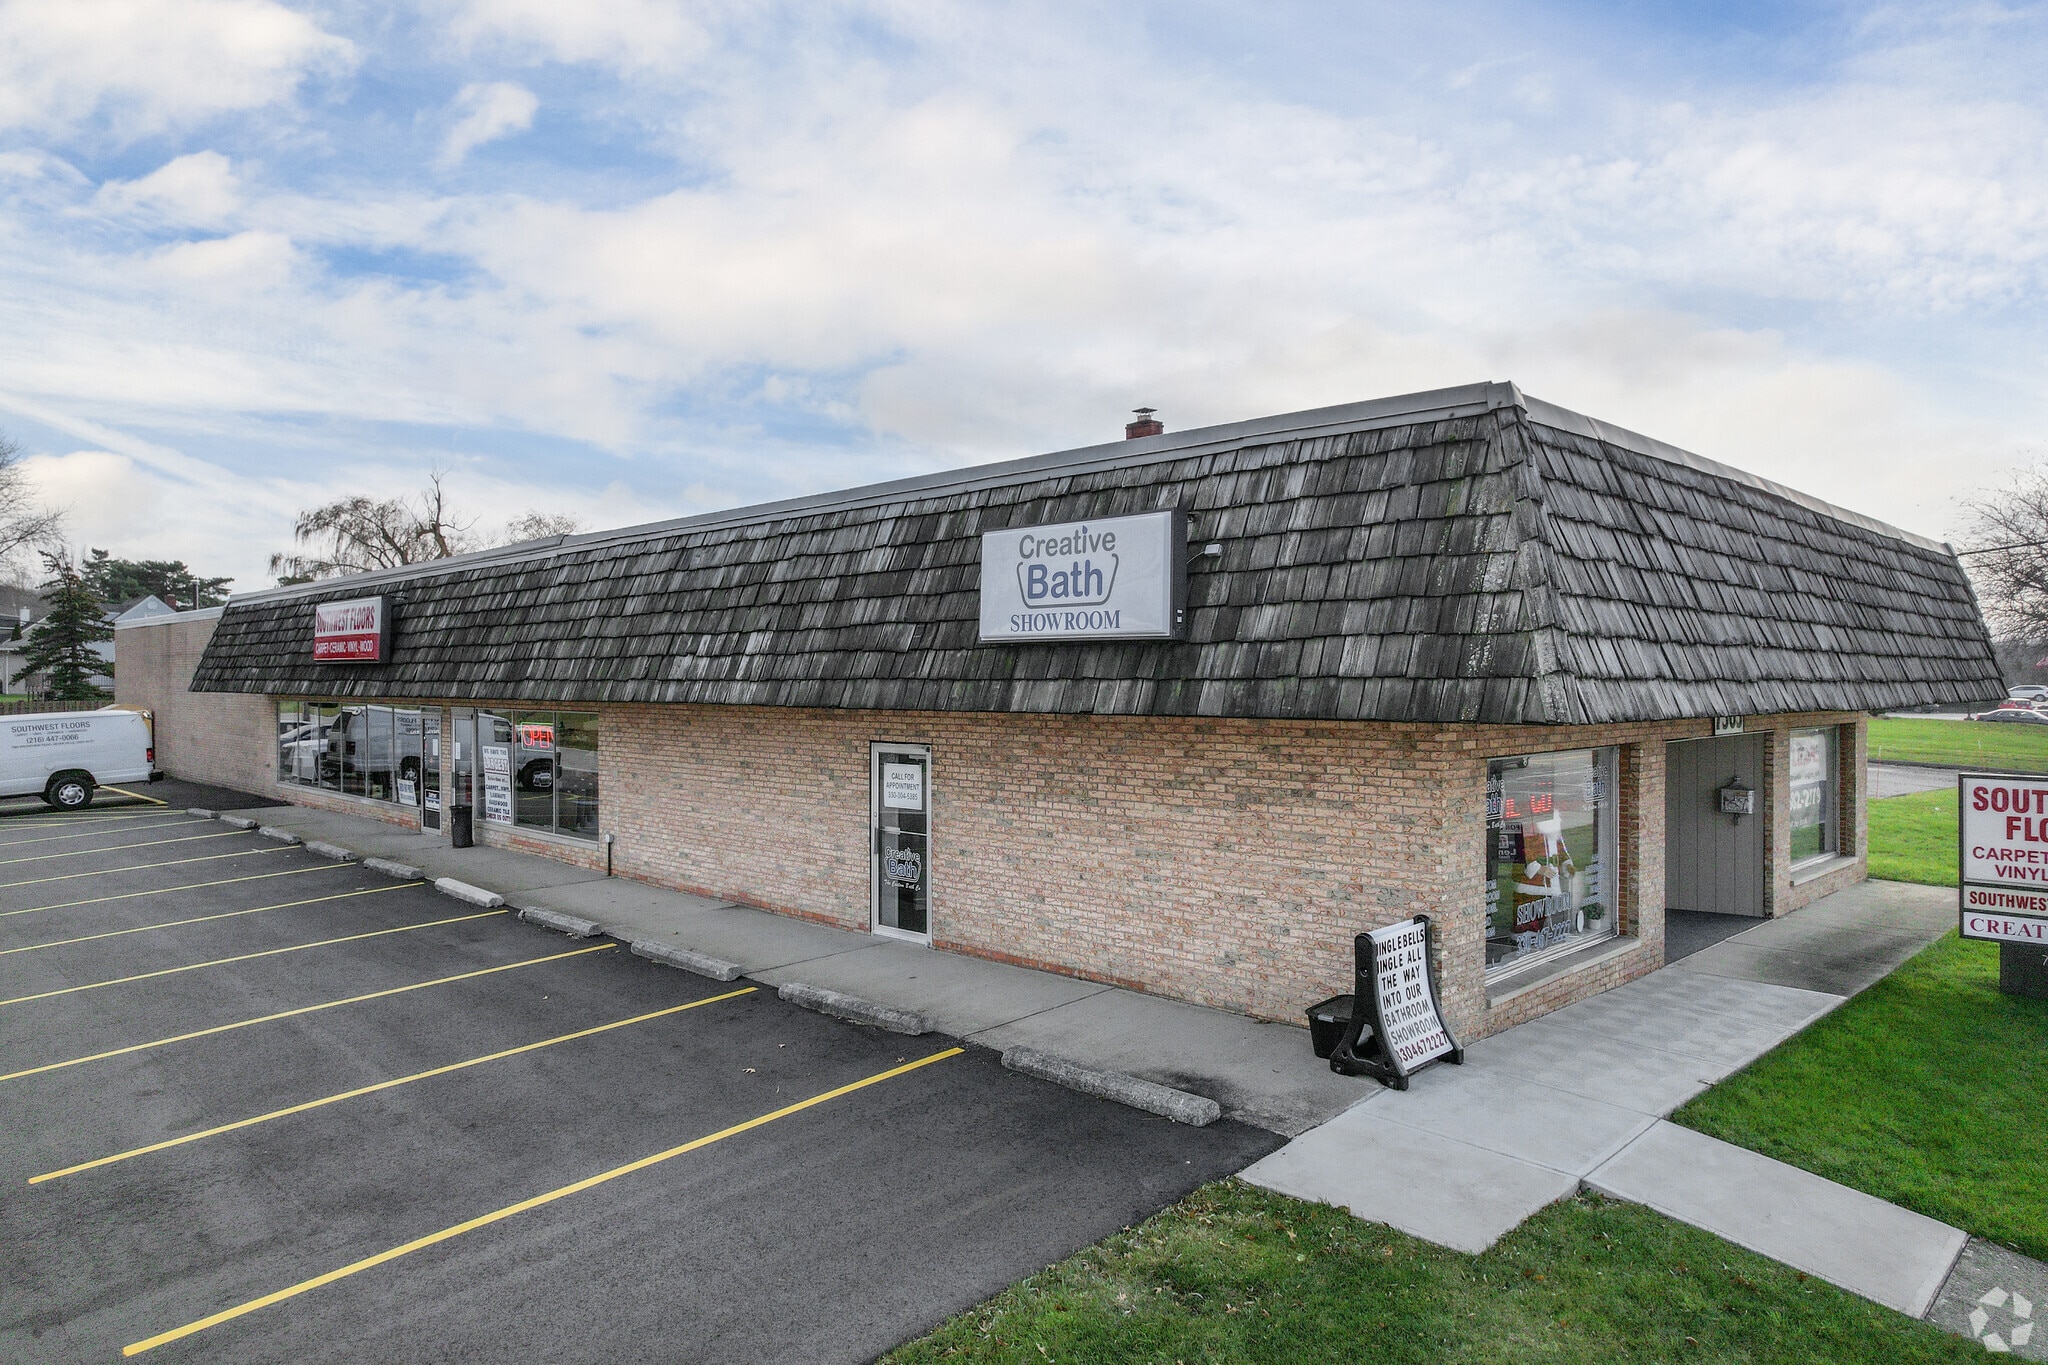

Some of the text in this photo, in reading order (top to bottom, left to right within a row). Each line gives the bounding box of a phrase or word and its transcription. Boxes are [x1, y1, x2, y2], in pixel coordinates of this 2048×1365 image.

[1019, 525, 1116, 559] Creative
[1027, 560, 1103, 599] Bath
[350, 605, 375, 631] FLOORS
[1010, 610, 1121, 633] SHOWROOM
[11, 721, 91, 733] SOUTHWEST FLOORS
[522, 725, 554, 749] OPEN
[26, 736, 45, 744] (216)
[46, 733, 79, 742] 447-0066
[886, 781, 920, 791] APPOINTMENT
[891, 772, 915, 781] CALL FOR
[1486, 774, 1505, 794] ative
[1586, 780, 1606, 797] Bath
[1486, 793, 1503, 816] ath
[1972, 786, 2048, 814] SOUT
[884, 846, 920, 862] Creative
[1972, 846, 2048, 865] CARPET
[888, 858, 918, 878] Bath
[1994, 864, 2048, 882] VINYL
[1516, 892, 1572, 926] SHOWROOM
[1969, 891, 2048, 912] SOUTHWES
[1402, 929, 1425, 948] BELLS
[1969, 917, 2047, 939] CREAT
[1407, 947, 1422, 964] ALL
[1382, 965, 1421, 991] THE WAY
[1382, 983, 1422, 1010] INTO OUR
[1384, 999, 1431, 1028] BATHROOM
[1390, 1015, 1440, 1045] SHOWROOM
